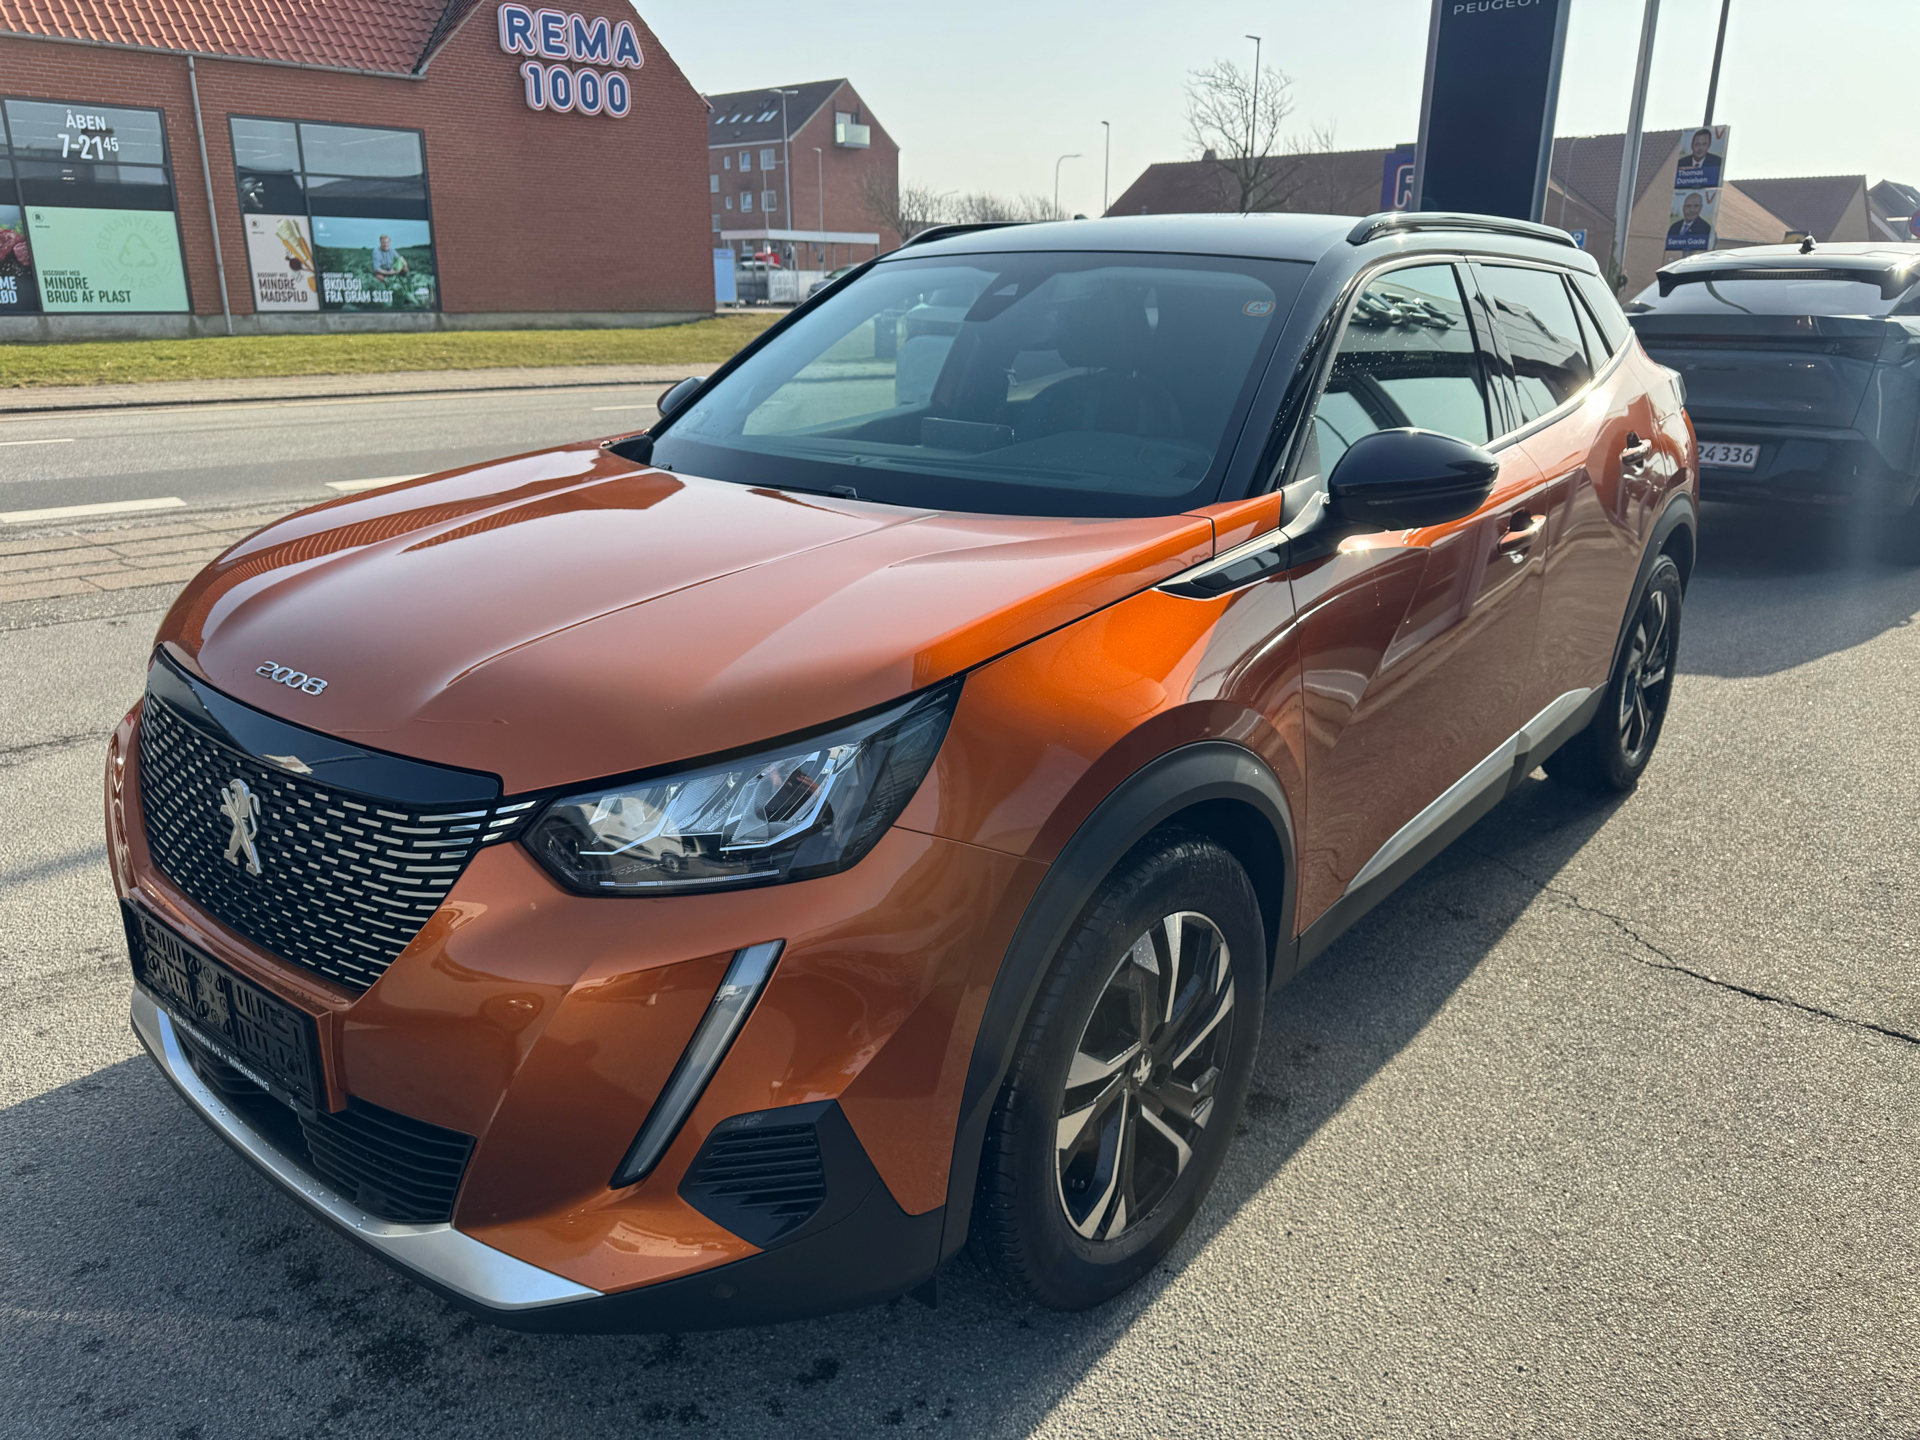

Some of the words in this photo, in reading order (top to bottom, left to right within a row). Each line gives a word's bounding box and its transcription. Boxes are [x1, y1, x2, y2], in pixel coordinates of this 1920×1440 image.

[497, 3, 644, 69] REMA
[519, 60, 631, 118] 1000
[66, 109, 106, 131] ÅBEN
[44, 277, 90, 290] MINDRE
[258, 278, 296, 290] MINDRE
[0, 290, 18, 304] ØD
[46, 290, 78, 303] BRUG
[82, 290, 94, 303] AF
[98, 290, 131, 303] PLAST
[260, 290, 308, 303] MADSPILD
[1718, 446, 1753, 463] 336
[256, 660, 328, 696] 2008
